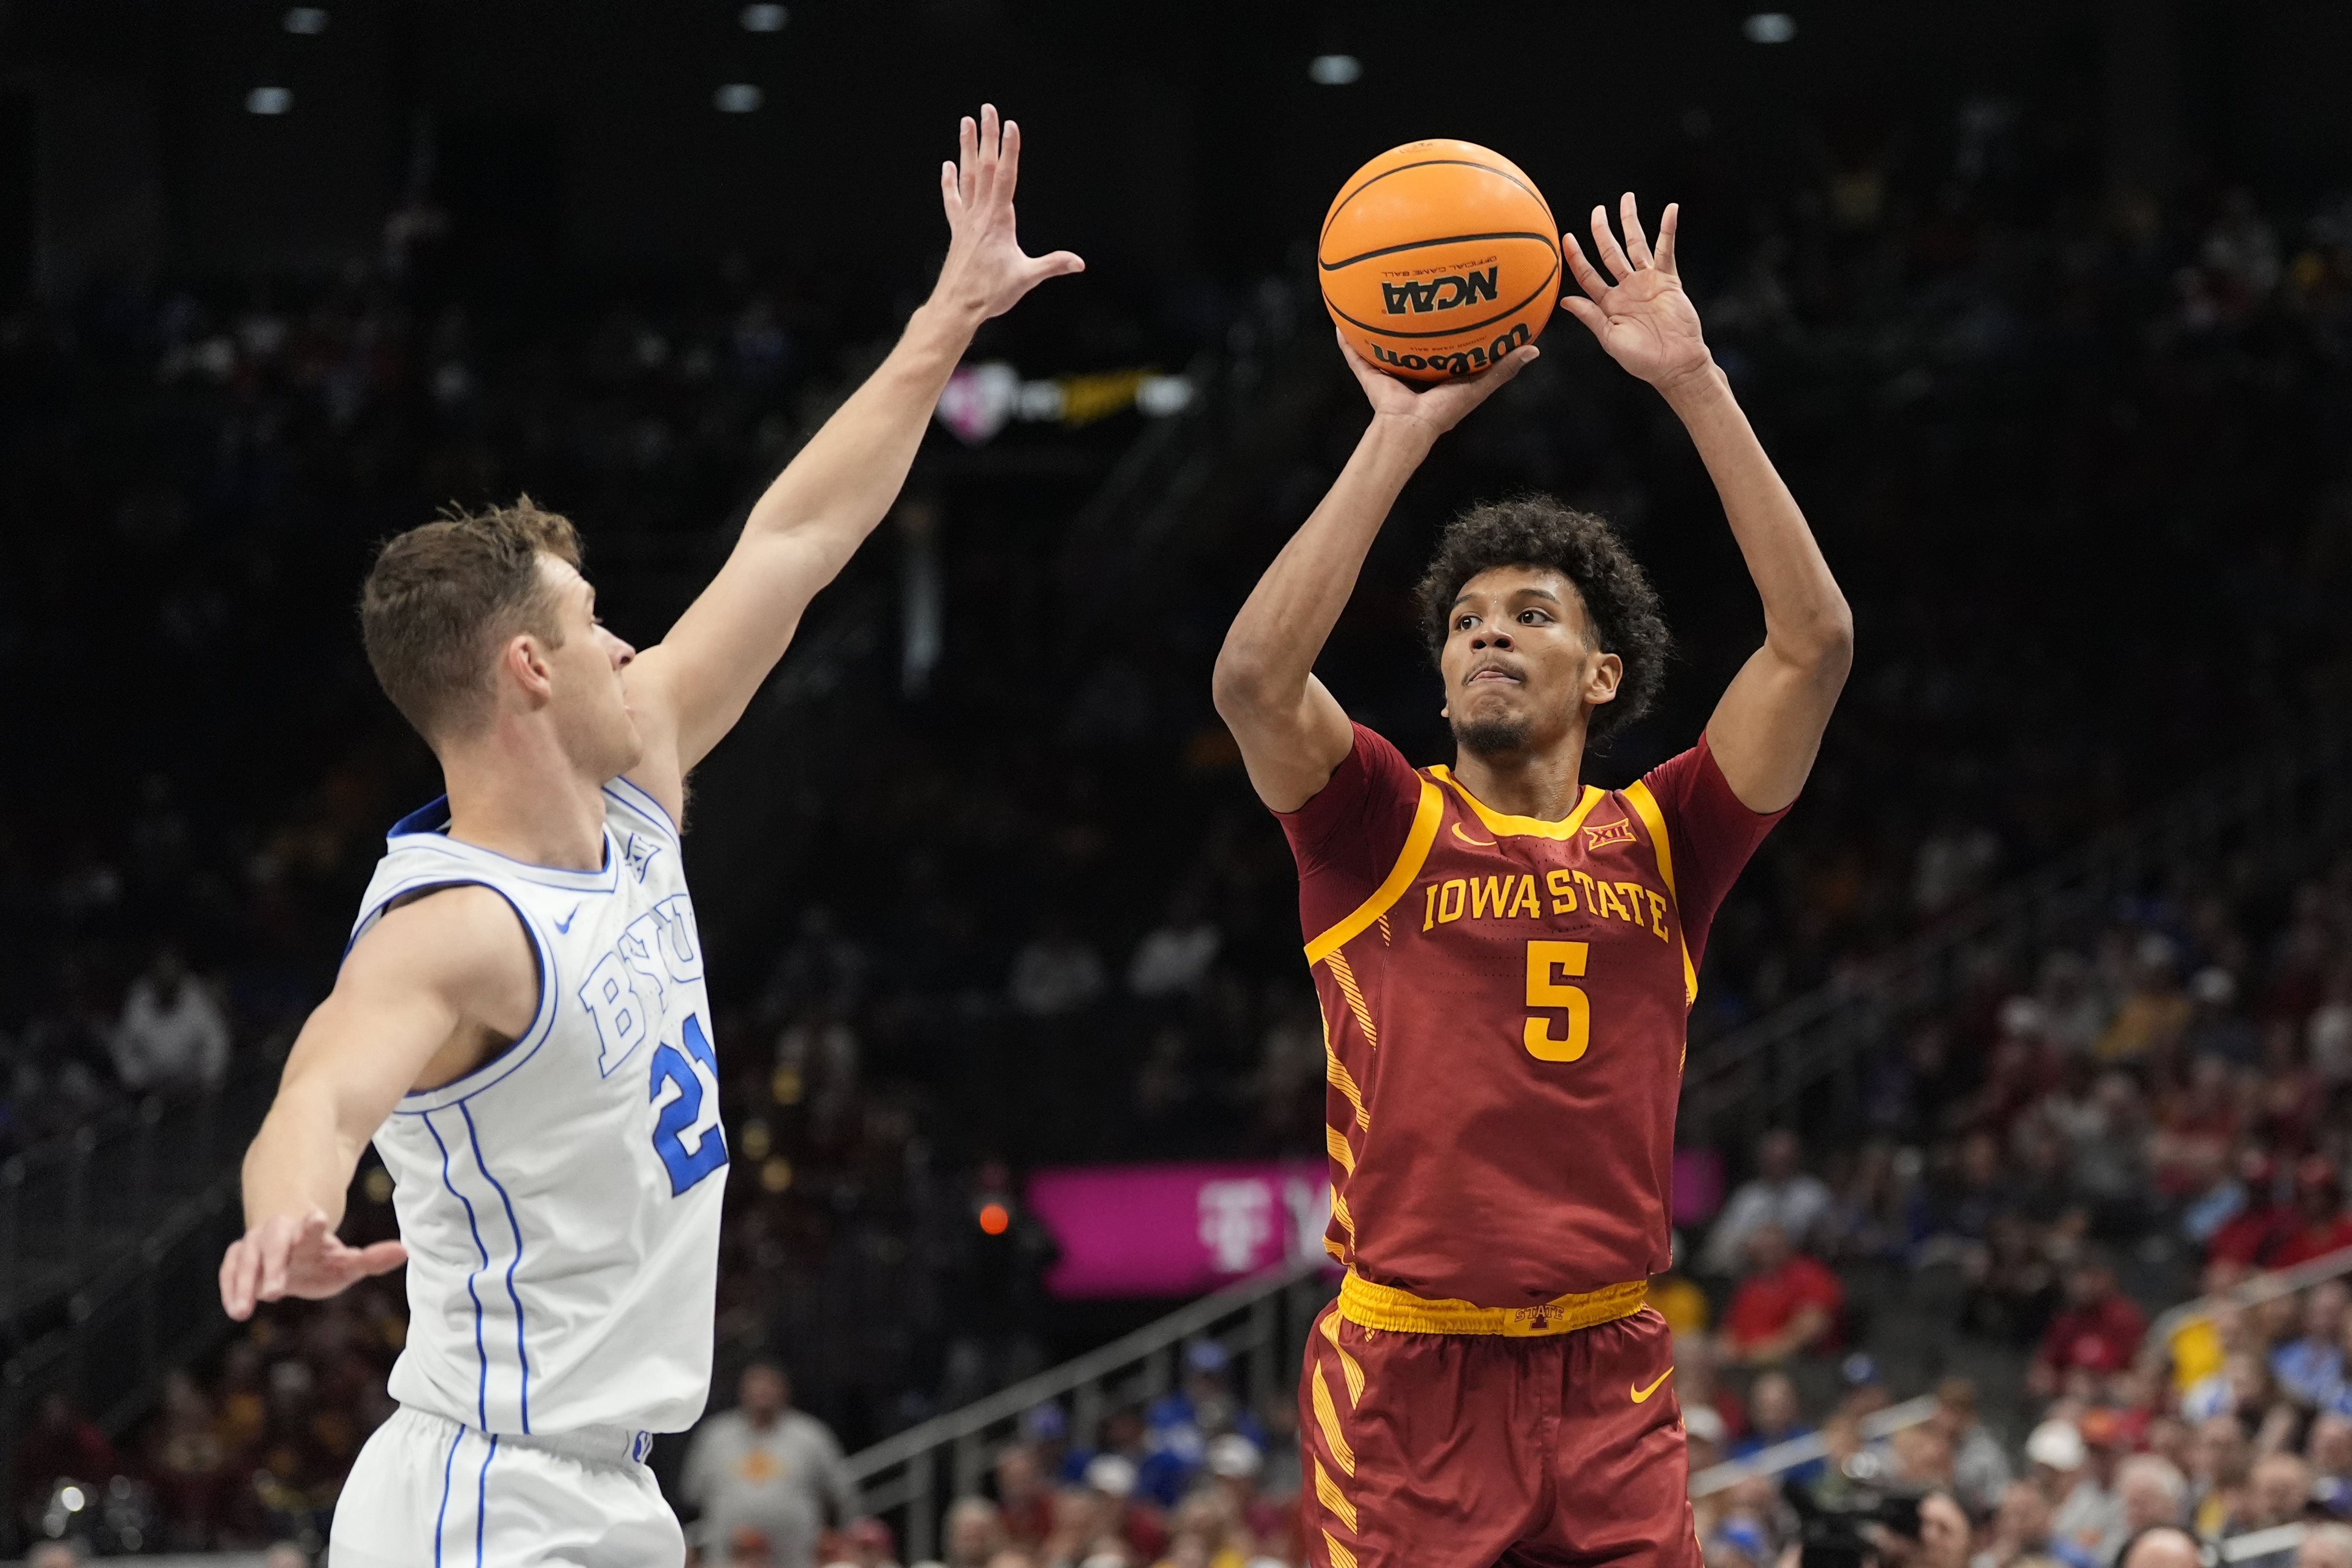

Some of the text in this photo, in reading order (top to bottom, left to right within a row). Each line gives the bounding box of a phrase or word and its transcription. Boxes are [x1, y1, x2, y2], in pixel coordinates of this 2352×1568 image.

[1413, 267, 1446, 276] GAME
[1449, 256, 1498, 271] OFFICIAL
[1382, 265, 1498, 315] NCAA
[1371, 323, 1533, 375] Wilson
[1422, 869, 1670, 944] IOWA STATE
[579, 893, 703, 1079] BYU
[1523, 940, 1591, 1062] 5
[1514, 1305, 1564, 1323] STATE
